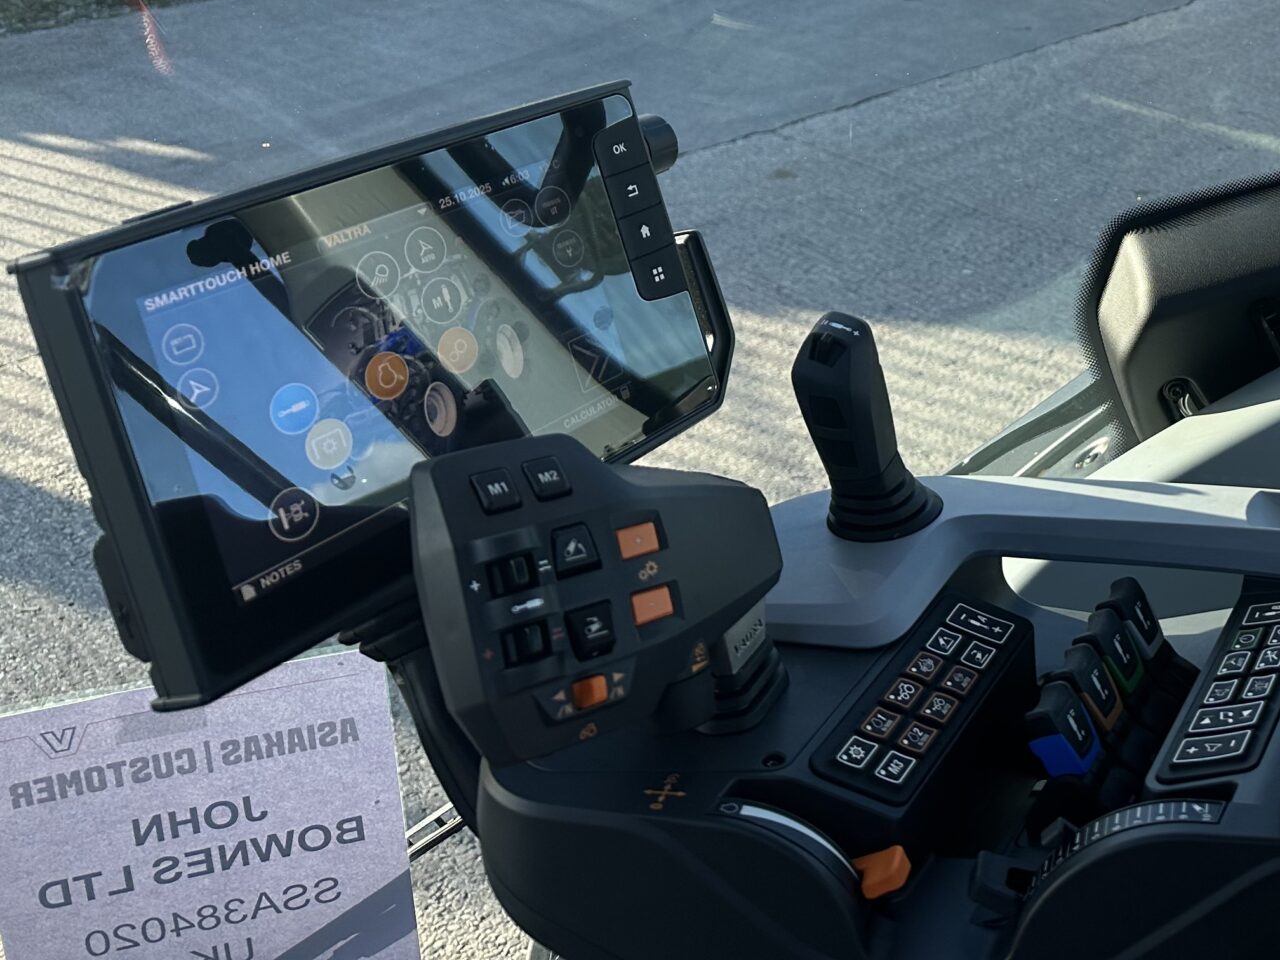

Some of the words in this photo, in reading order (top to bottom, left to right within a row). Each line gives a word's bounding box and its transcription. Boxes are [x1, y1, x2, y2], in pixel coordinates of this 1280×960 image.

[612, 142, 627, 155] OK
[323, 223, 372, 248] VALTRA
[144, 267, 248, 312] SMARTTOUCH
[249, 251, 292, 276] HOME
[563, 394, 619, 429] CALCULATOR
[537, 470, 560, 484] M2
[487, 481, 509, 496] M1
[259, 559, 303, 589] NOTES
[887, 759, 904, 775] M3
